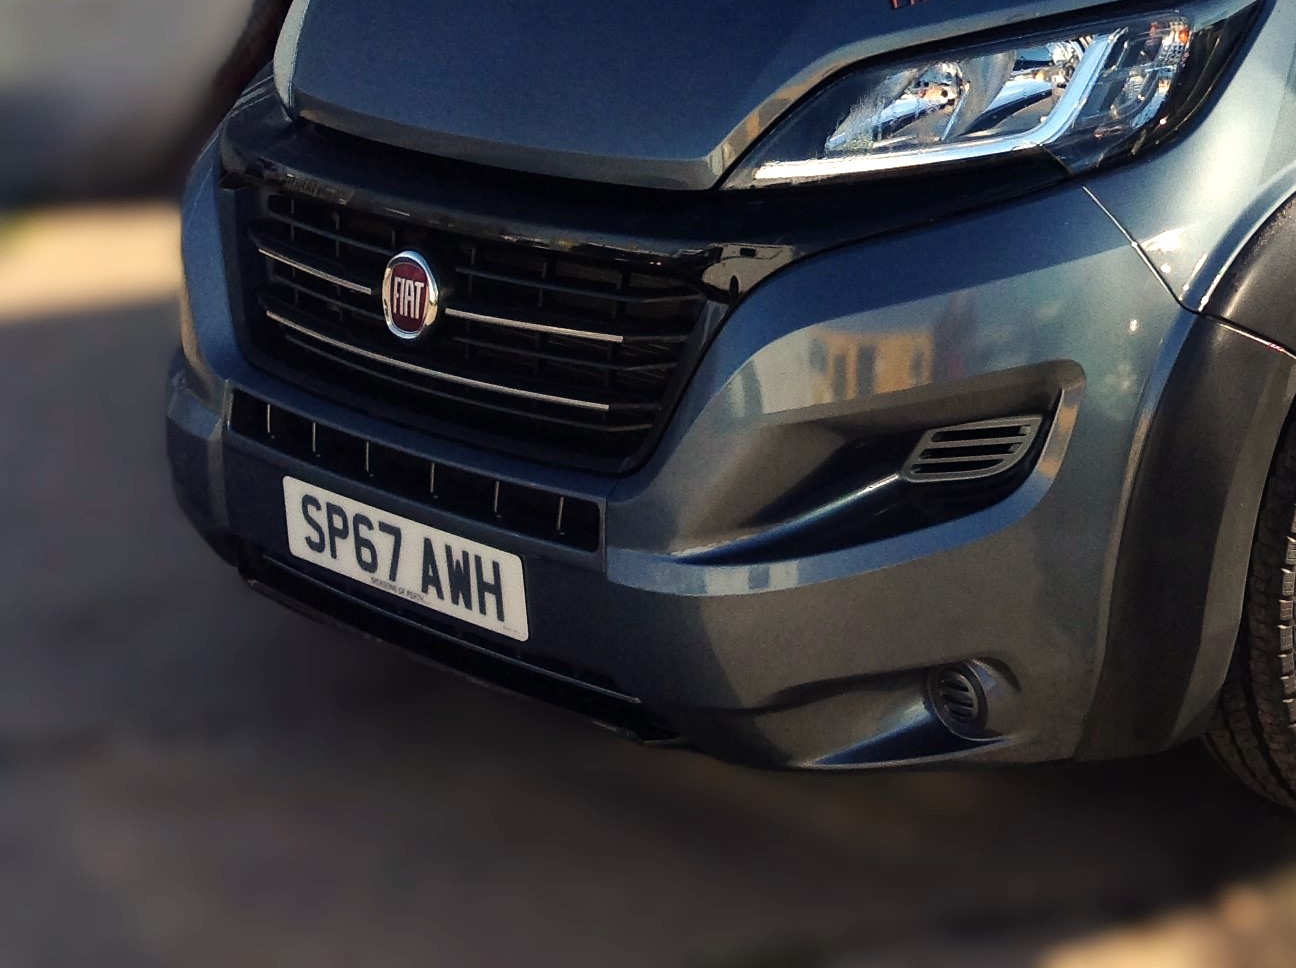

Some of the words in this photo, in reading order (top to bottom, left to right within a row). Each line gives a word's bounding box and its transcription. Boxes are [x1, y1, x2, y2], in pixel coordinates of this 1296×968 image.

[393, 276, 425, 320] FIAT
[302, 494, 402, 582] SP67
[421, 537, 505, 622] AWH
